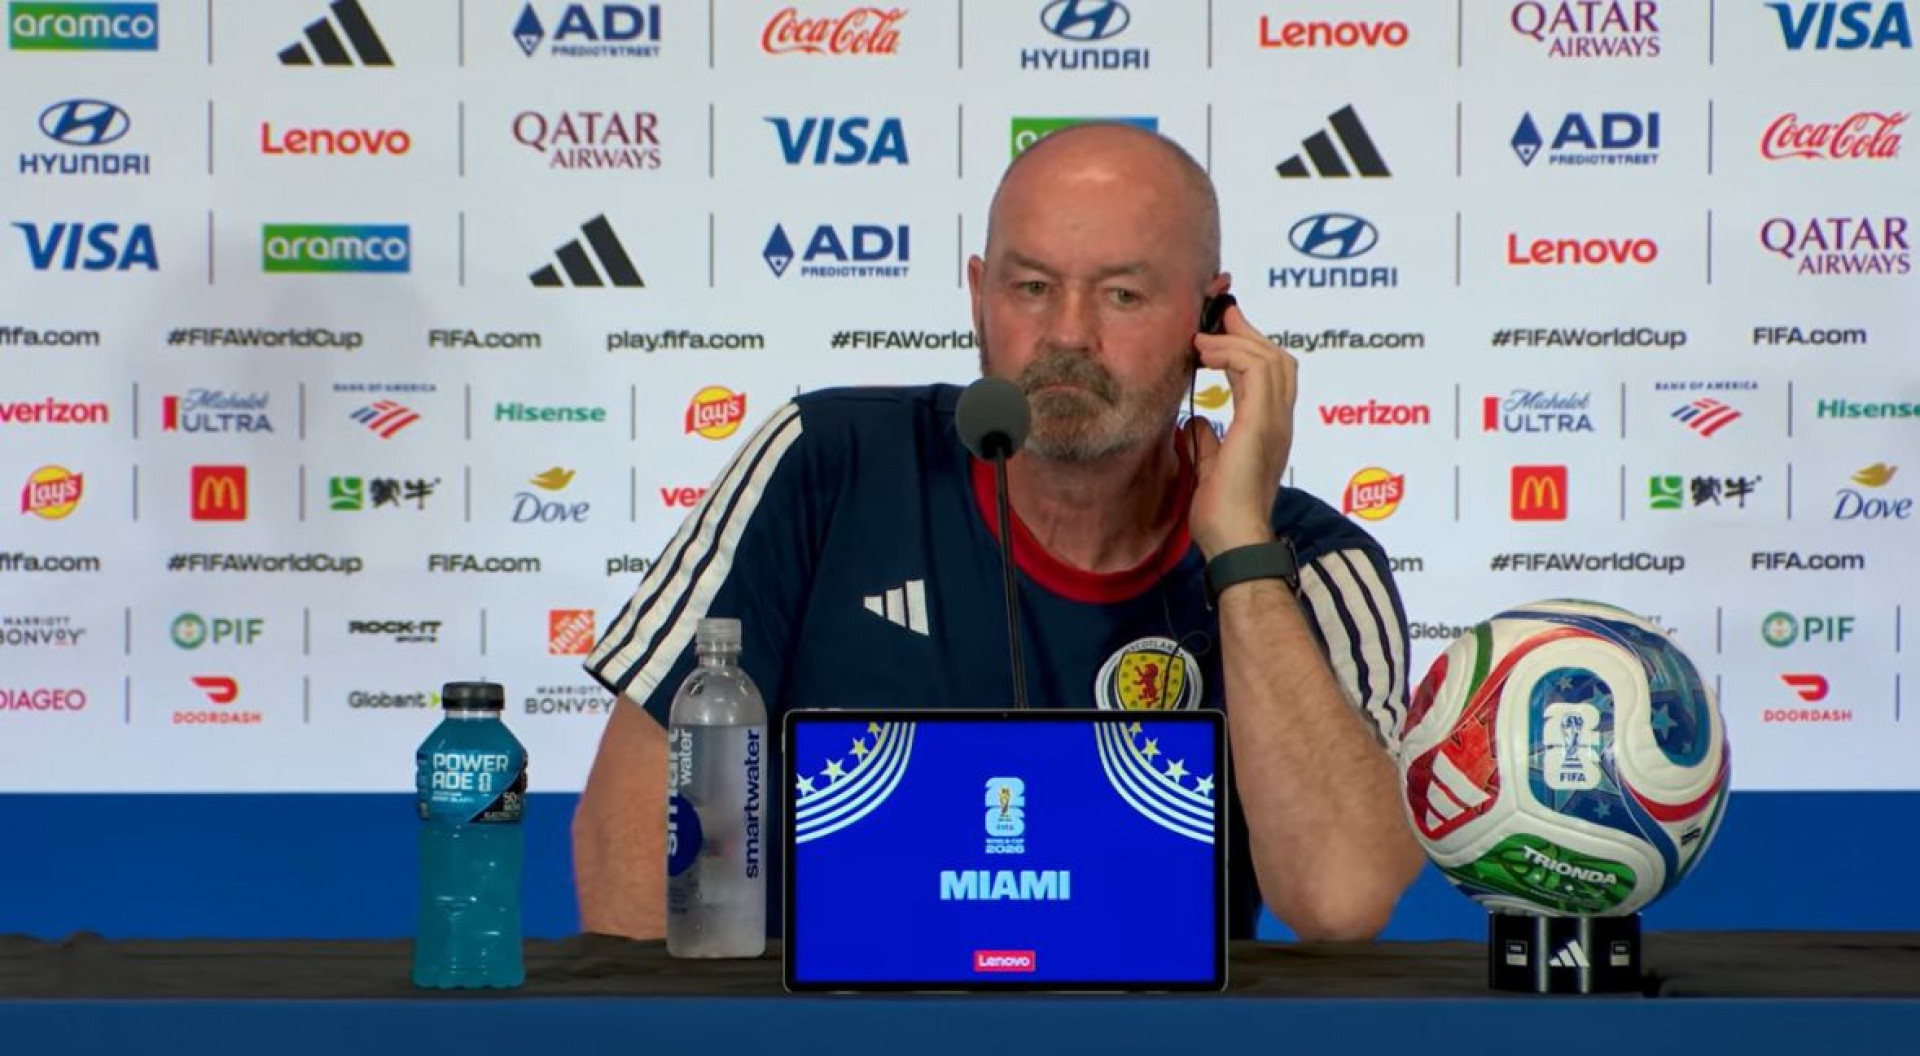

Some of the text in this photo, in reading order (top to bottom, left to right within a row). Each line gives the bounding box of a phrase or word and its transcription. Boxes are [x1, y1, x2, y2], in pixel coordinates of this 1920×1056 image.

[12, 10, 154, 38] aramco
[554, 5, 660, 40] ADI
[762, 7, 906, 54] Coca-Cola
[1260, 15, 1408, 47] Lenovo
[1511, 0, 1659, 41] QATAR
[1764, 1, 1913, 49] VISA
[1020, 48, 1149, 69] HYUNDAI
[1549, 36, 1660, 57] AIRWAYS
[261, 121, 411, 155] Lenovo
[513, 110, 660, 152] QATAR
[764, 117, 909, 165] VISA
[1552, 112, 1660, 149] ADI
[1760, 111, 1911, 159] Coca-Cola
[19, 154, 151, 175] HYUNDAI
[549, 150, 661, 170] AIRWAYS
[10, 222, 160, 271] VISA
[267, 233, 406, 262] aramco
[802, 225, 910, 262] ADI
[1508, 234, 1657, 265] Lenovo
[1760, 217, 1909, 259] QATAR
[1798, 254, 1911, 275] AIRWAYS
[1268, 268, 1398, 289] HYUNDAI
[167, 327, 363, 350] #FIFAWorldCup
[429, 329, 542, 349] FIFA.com
[607, 329, 765, 352] play.fifa.com
[831, 330, 977, 349] #FIFAWorld
[1490, 327, 1687, 350] #FIFAWorldCup
[1753, 327, 1867, 346] FIFA.com
[1655, 381, 1687, 390] BANK
[1707, 381, 1759, 390] AMERICA
[0, 396, 109, 423] verizon
[181, 413, 273, 432] ULTRA
[495, 403, 606, 422] Hisense
[1319, 399, 1431, 425] verizon
[1504, 413, 1593, 432] ULTRA
[511, 492, 589, 523] Dove
[1833, 488, 1912, 520] Dove
[167, 552, 363, 575] #FIFAWorldCup
[428, 554, 541, 573] FIFA.com
[1490, 552, 1686, 574] #FIFAWorldCup
[1751, 551, 1865, 571] FIFA.com
[212, 618, 264, 644] PIF
[348, 620, 442, 634] ROCK-IT
[1804, 616, 1855, 643] PIF
[347, 690, 428, 709] Globant
[524, 697, 614, 715] BONVOY
[172, 711, 261, 724] DOORDASH
[1763, 709, 1852, 722] DOORDASH
[433, 753, 509, 772] POWER
[680, 730, 694, 787] water
[432, 771, 475, 790] ADE
[1560, 772, 1586, 782] FIFA
[744, 729, 761, 880] smartwater
[985, 844, 1025, 854] 2026
[1523, 845, 1617, 884] TRIONDA
[940, 870, 1070, 900] MIAMI
[978, 954, 1030, 967] Lenovo
